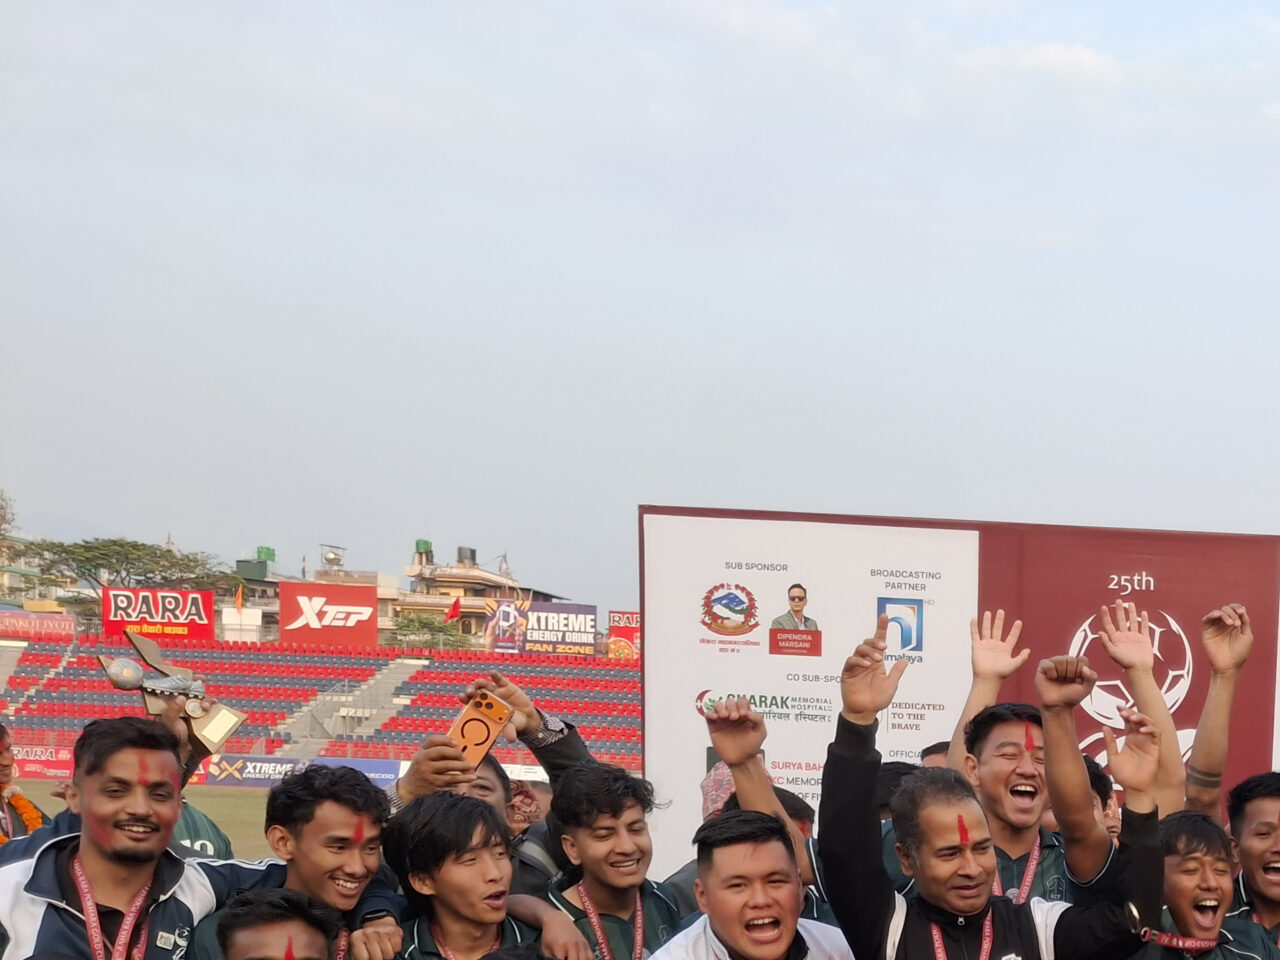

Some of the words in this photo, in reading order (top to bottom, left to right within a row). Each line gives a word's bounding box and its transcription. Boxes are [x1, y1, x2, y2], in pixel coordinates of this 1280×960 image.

[725, 562, 743, 570] SUB
[745, 562, 788, 572] SPONSOR
[870, 569, 942, 580] BROADCASTING
[885, 581, 927, 591] PARTNER
[1108, 572, 1155, 596] 25th
[109, 590, 209, 624] RARA
[284, 596, 374, 630] XTEP
[527, 612, 596, 632] XTREME
[527, 630, 562, 642] ENERGY
[565, 631, 595, 643] DRINK
[777, 633, 812, 641] DIPENDRA
[525, 643, 553, 651] FAN
[556, 644, 595, 654] ZONE
[884, 652, 923, 664] imalaya
[786, 673, 800, 681] CO
[801, 674, 842, 683] SUB-SPO
[891, 702, 945, 711] DEDICATED
[891, 723, 921, 731] BRAVE
[888, 750, 921, 758] OFFICIA
[245, 761, 294, 773] XTREME
[771, 761, 801, 770] SURYA
[786, 778, 822, 786] MEMOR
[82, 892, 97, 927] POKHARA
[580, 894, 593, 913] GOLD
[586, 911, 605, 943] POKHARA
[89, 927, 102, 950] GOLD
[598, 942, 611, 960] RARA
